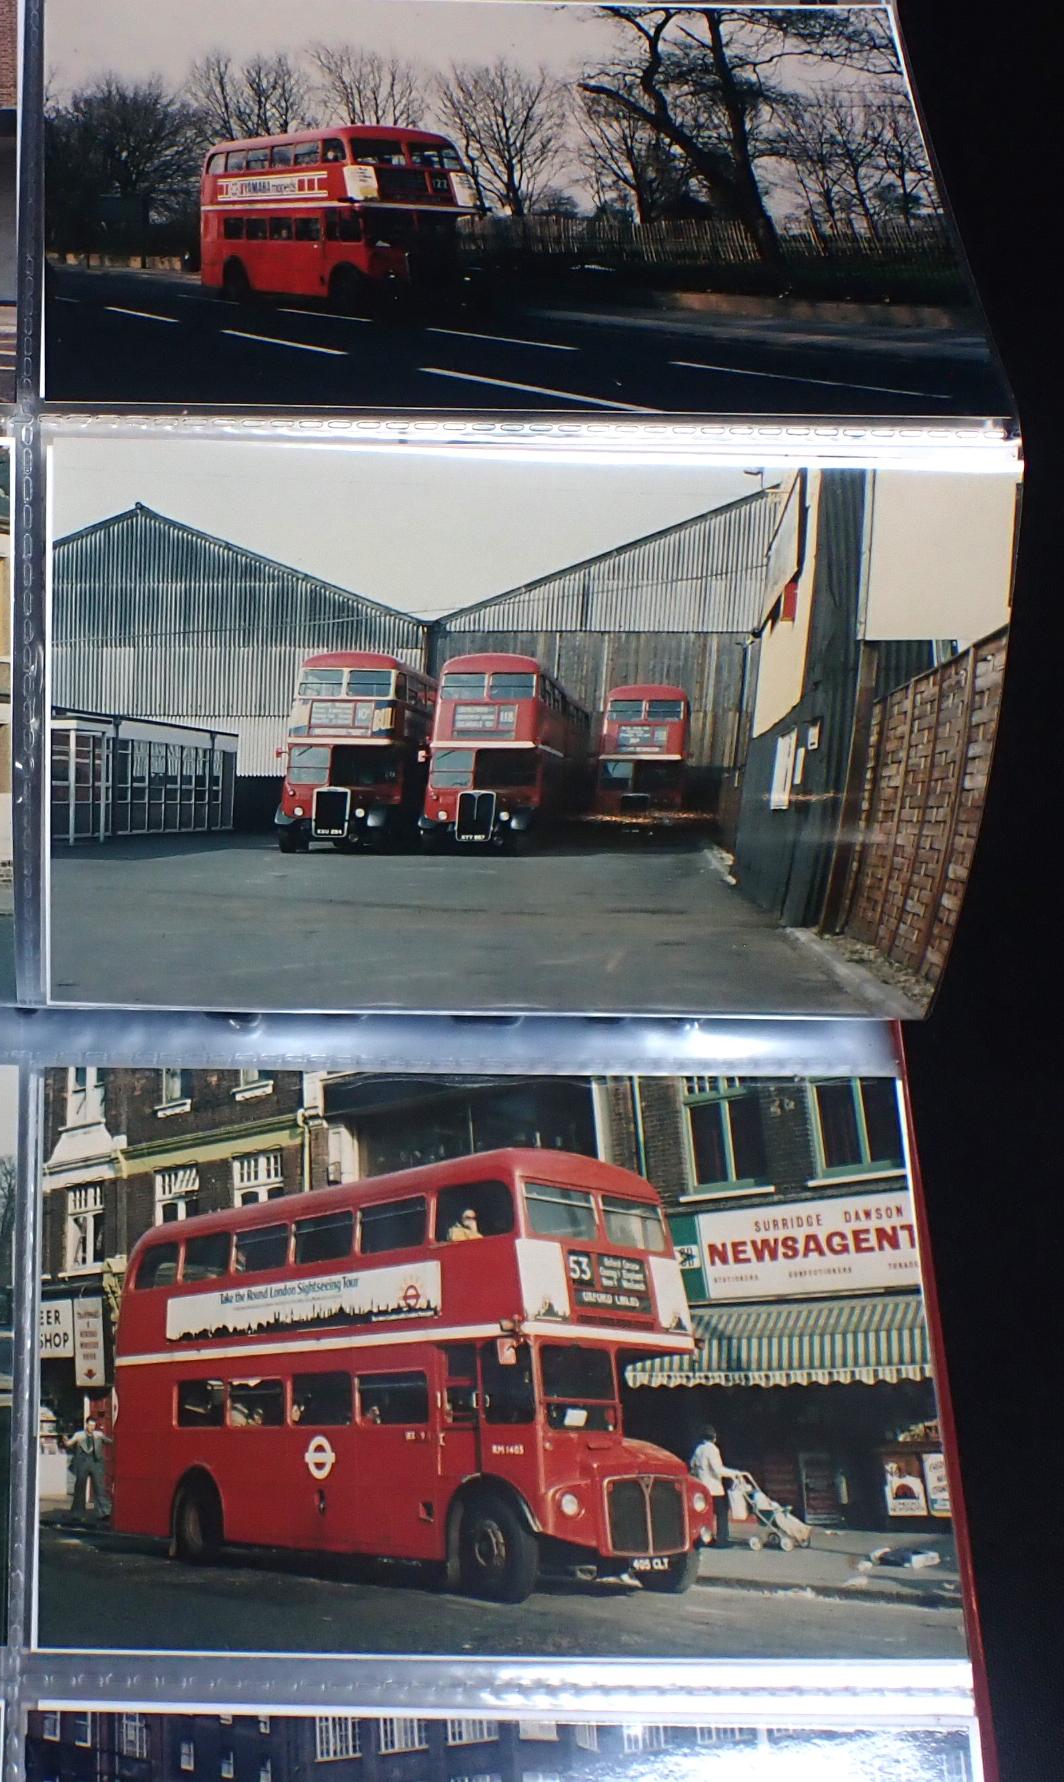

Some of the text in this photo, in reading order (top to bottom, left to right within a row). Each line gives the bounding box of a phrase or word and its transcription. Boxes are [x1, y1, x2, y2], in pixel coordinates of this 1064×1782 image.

[754, 1204, 904, 1233] SURRIDGE DAWSON
[569, 1255, 591, 1280] 53
[220, 1293, 234, 1305] Take
[234, 1291, 246, 1303] the
[246, 1287, 268, 1300] Round
[269, 1284, 297, 1299] London
[297, 1278, 342, 1295] Sightseeing
[342, 1276, 359, 1289] Tour
